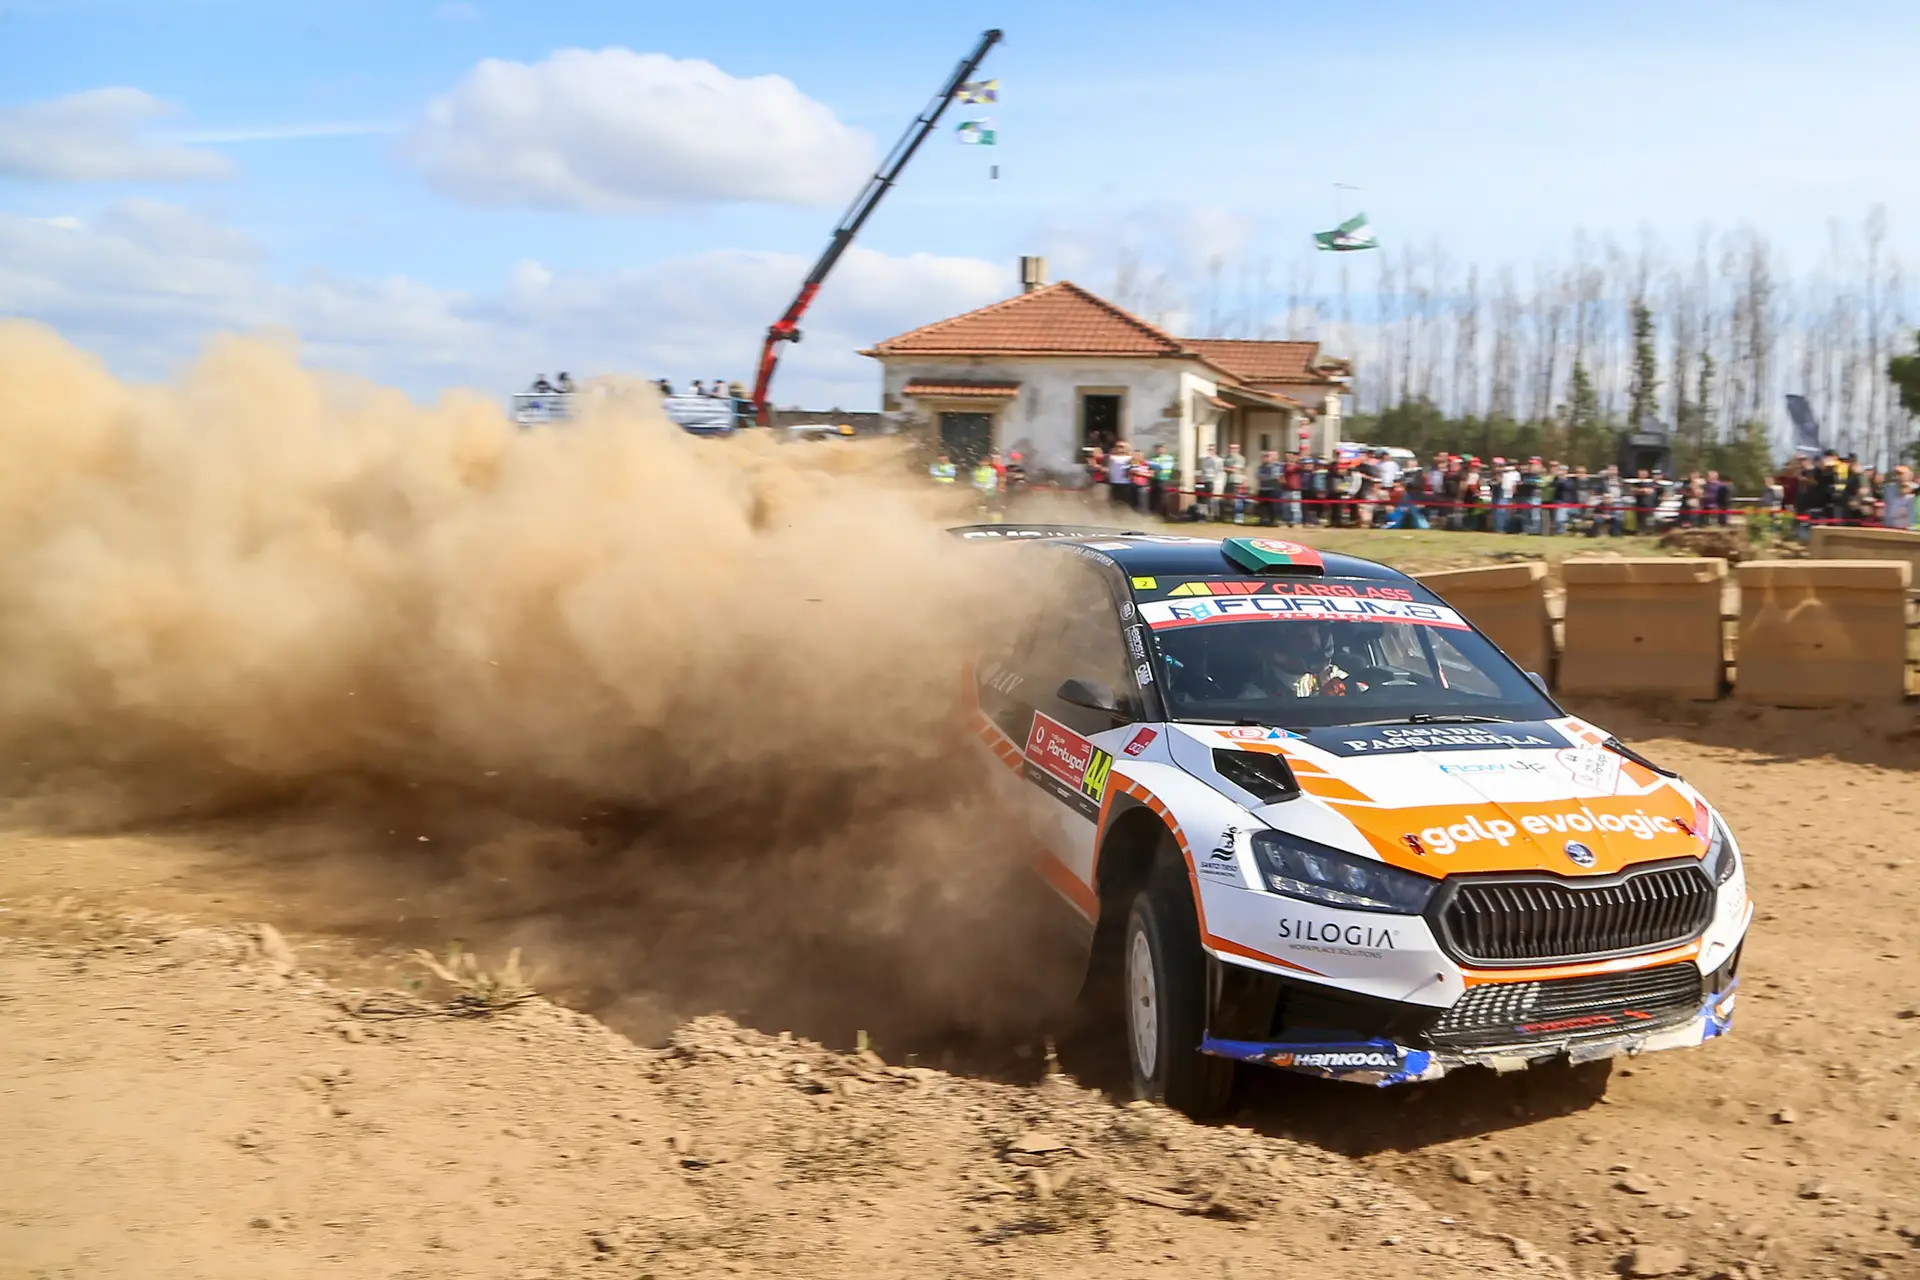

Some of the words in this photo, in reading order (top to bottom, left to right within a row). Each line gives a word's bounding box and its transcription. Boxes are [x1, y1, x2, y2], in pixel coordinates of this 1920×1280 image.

[1272, 583, 1414, 601] CARGLASS
[1213, 597, 1442, 621] FORUM8
[1046, 739, 1086, 772] Portugal
[1343, 735, 1552, 751] PASSARELLA
[1084, 749, 1113, 801] 44
[1421, 815, 1517, 854] galp
[1520, 806, 1679, 839] evologic
[1278, 918, 1396, 949] SILOGIA
